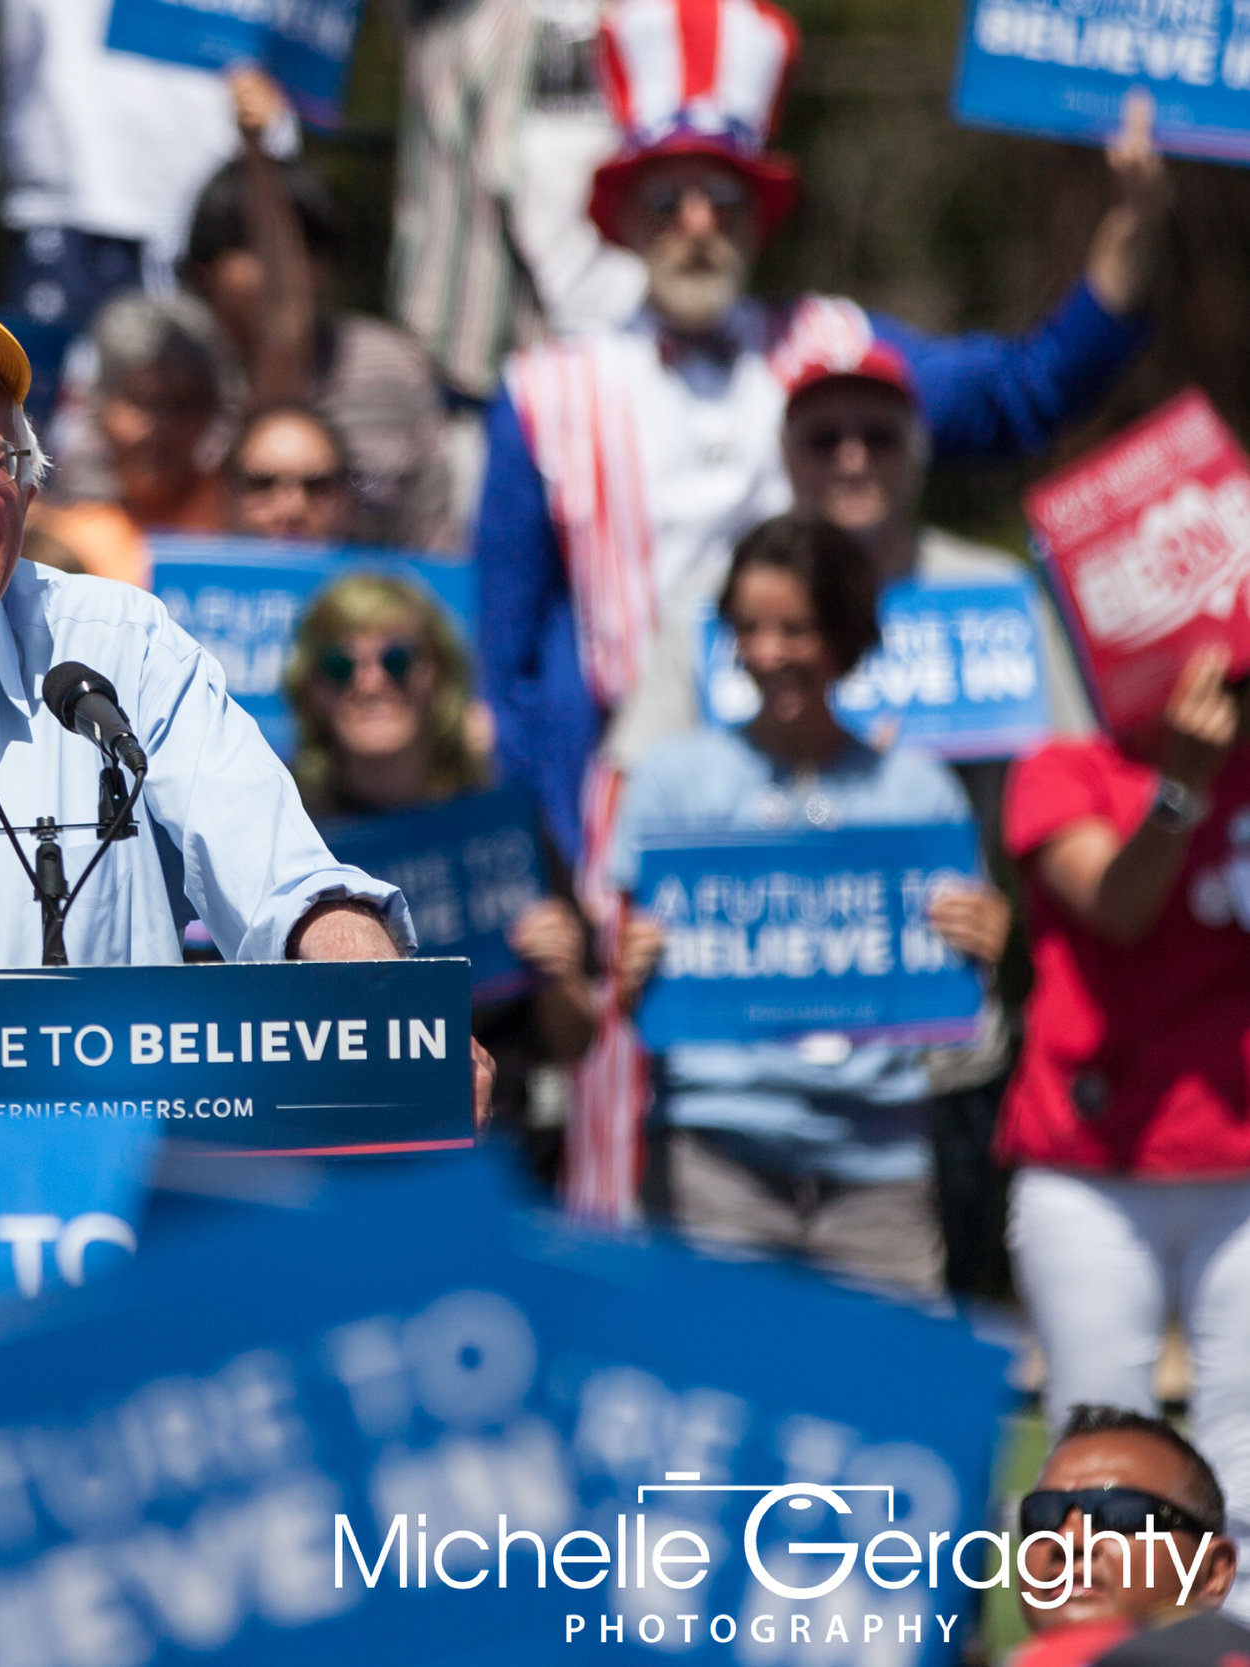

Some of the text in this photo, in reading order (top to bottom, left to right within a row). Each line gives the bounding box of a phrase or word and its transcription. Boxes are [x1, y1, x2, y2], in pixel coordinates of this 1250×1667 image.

[40, 1024, 113, 1066] TO
[130, 1019, 368, 1064] BELIEVE
[388, 1018, 448, 1061] IN
